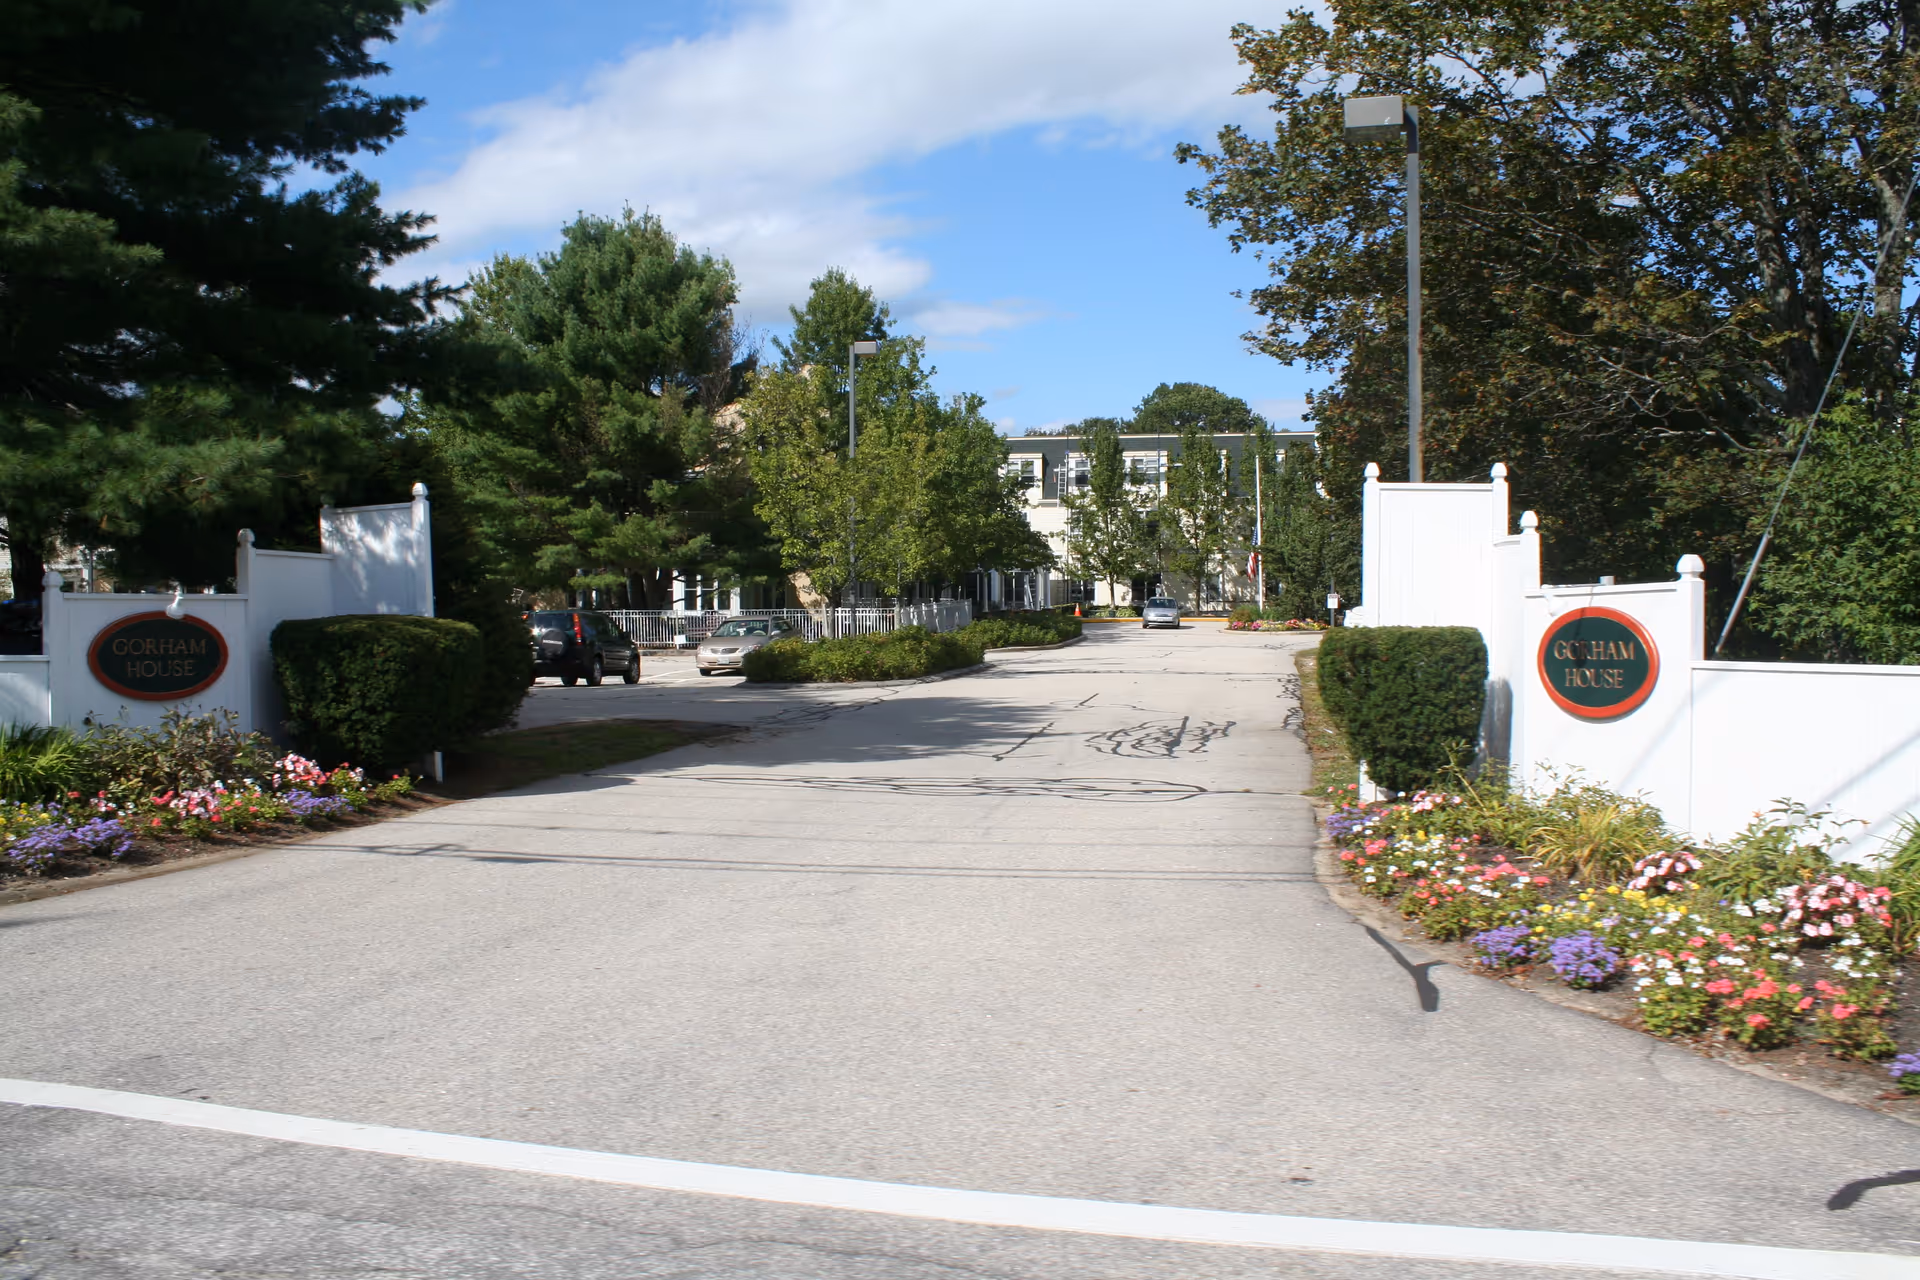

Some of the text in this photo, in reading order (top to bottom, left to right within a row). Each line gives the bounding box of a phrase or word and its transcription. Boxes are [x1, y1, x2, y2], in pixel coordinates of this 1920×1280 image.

[112, 638, 206, 655] GORHAM
[127, 660, 196, 678] HOUSE
[1564, 668, 1625, 688] HOUSE
